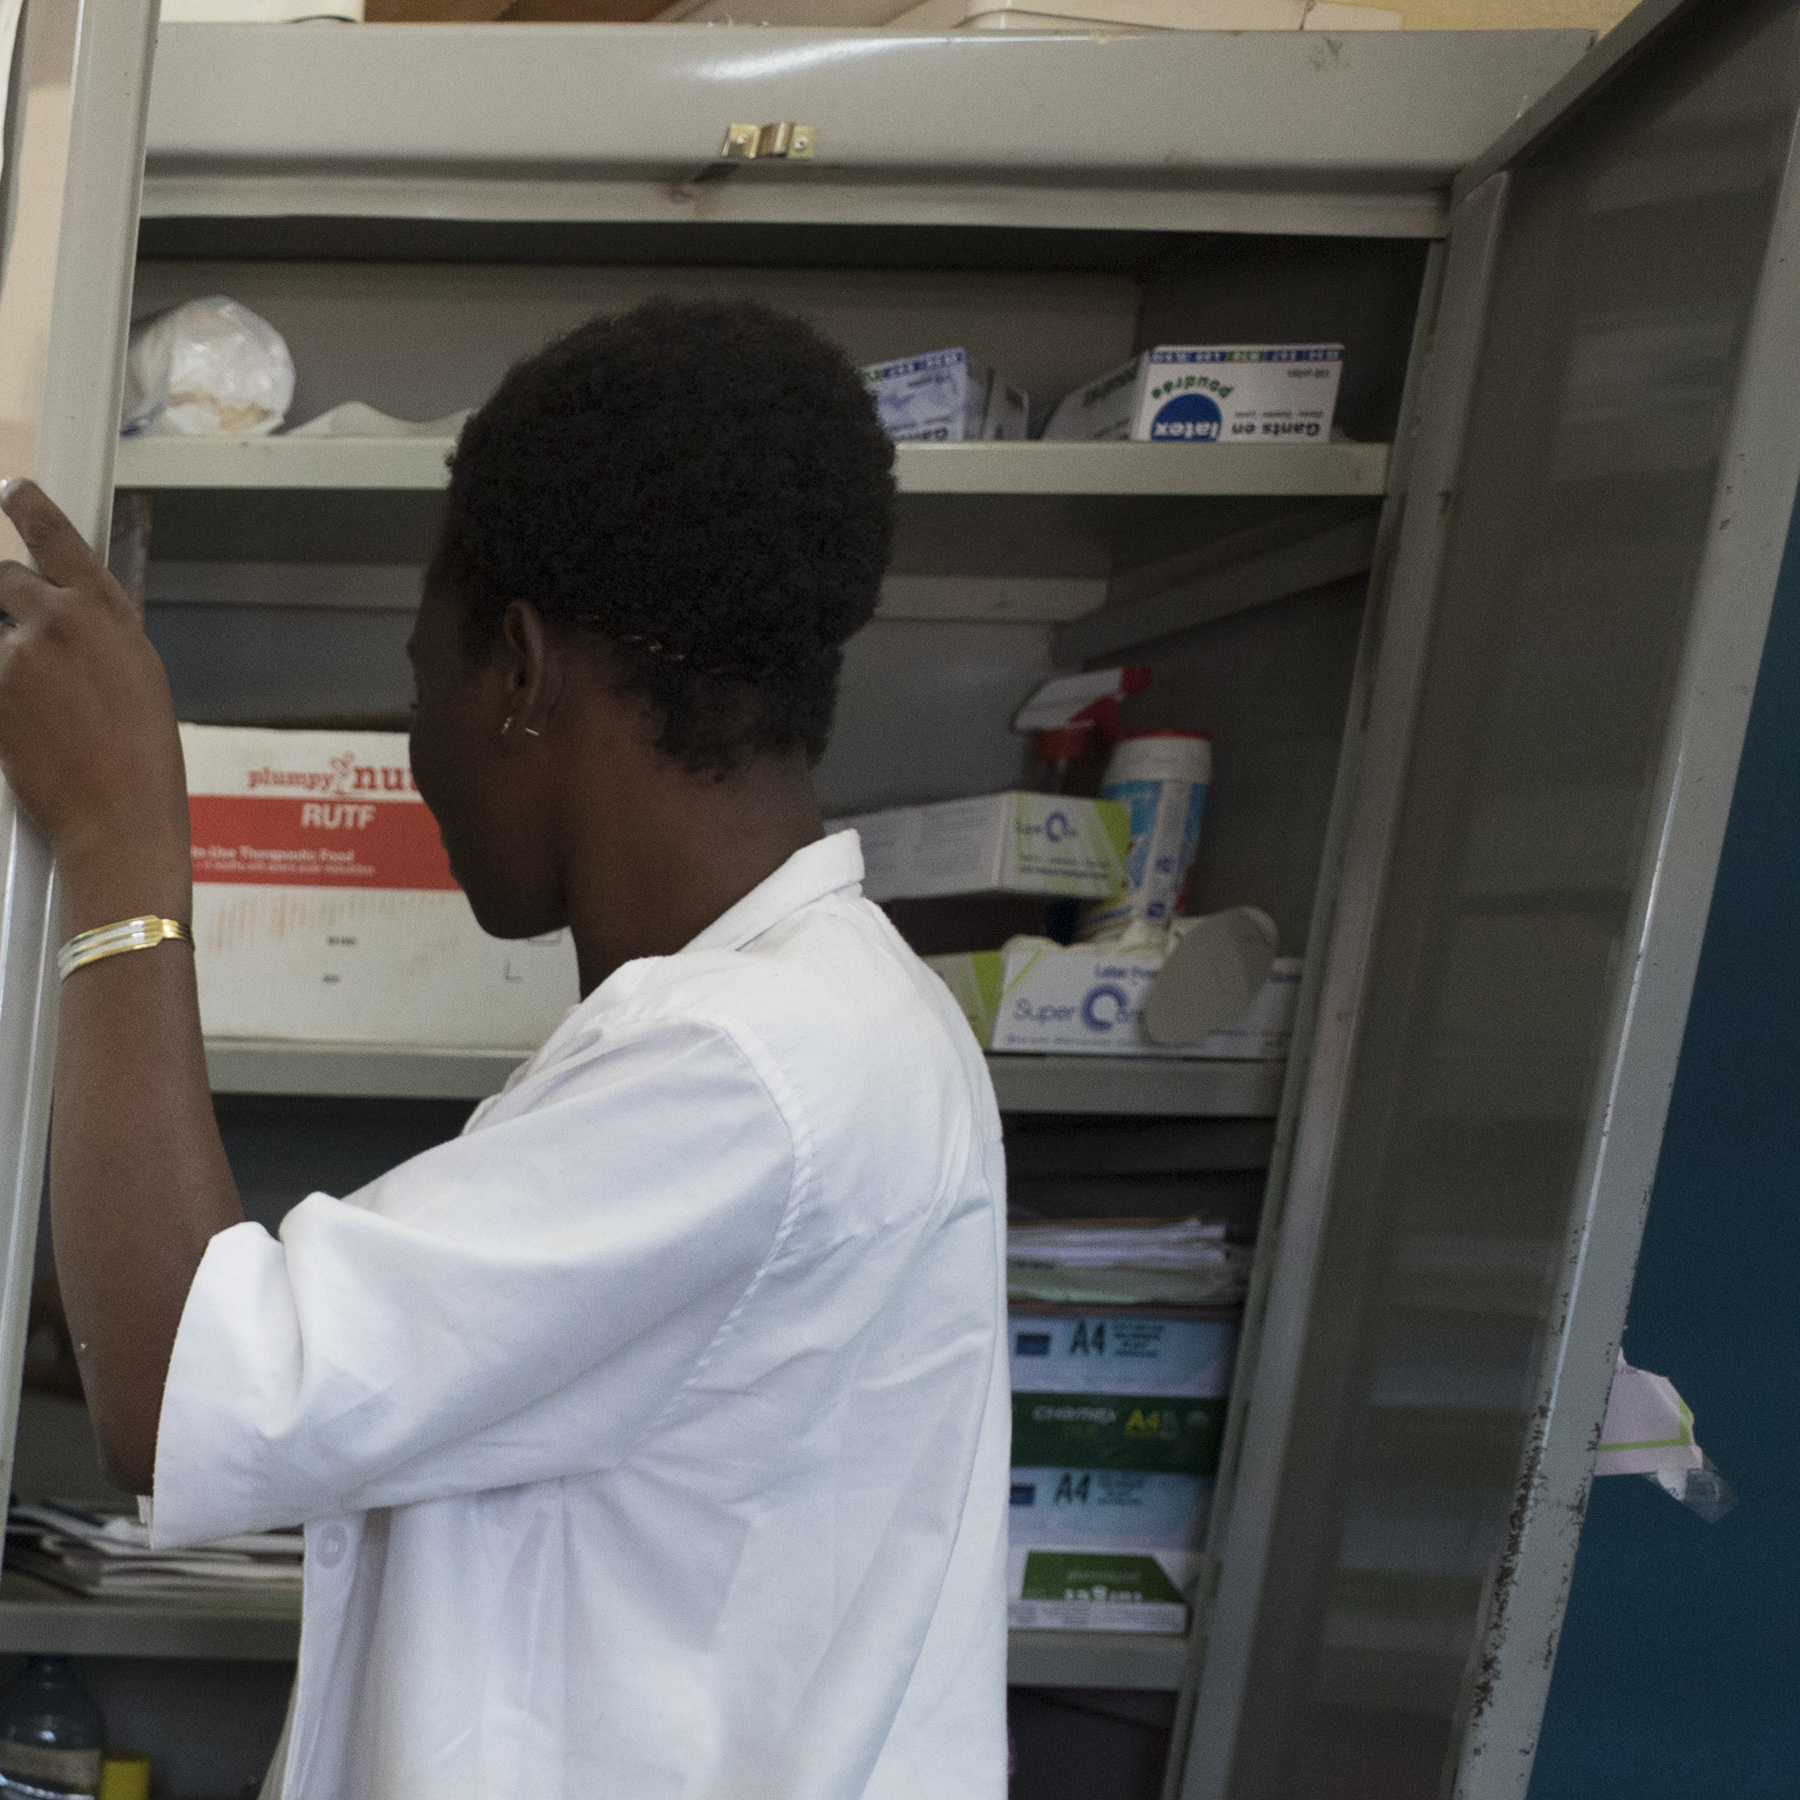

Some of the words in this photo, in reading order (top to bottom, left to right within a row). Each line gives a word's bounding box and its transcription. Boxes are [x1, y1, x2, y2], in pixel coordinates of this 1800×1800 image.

[1154, 421, 1220, 440] latex
[1262, 422, 1321, 437] Gants
[248, 766, 335, 791] plumpy
[351, 765, 416, 792] nu
[300, 802, 377, 830] RUTF
[1069, 1317, 1107, 1356] A4
[1053, 1472, 1092, 1506] A4
